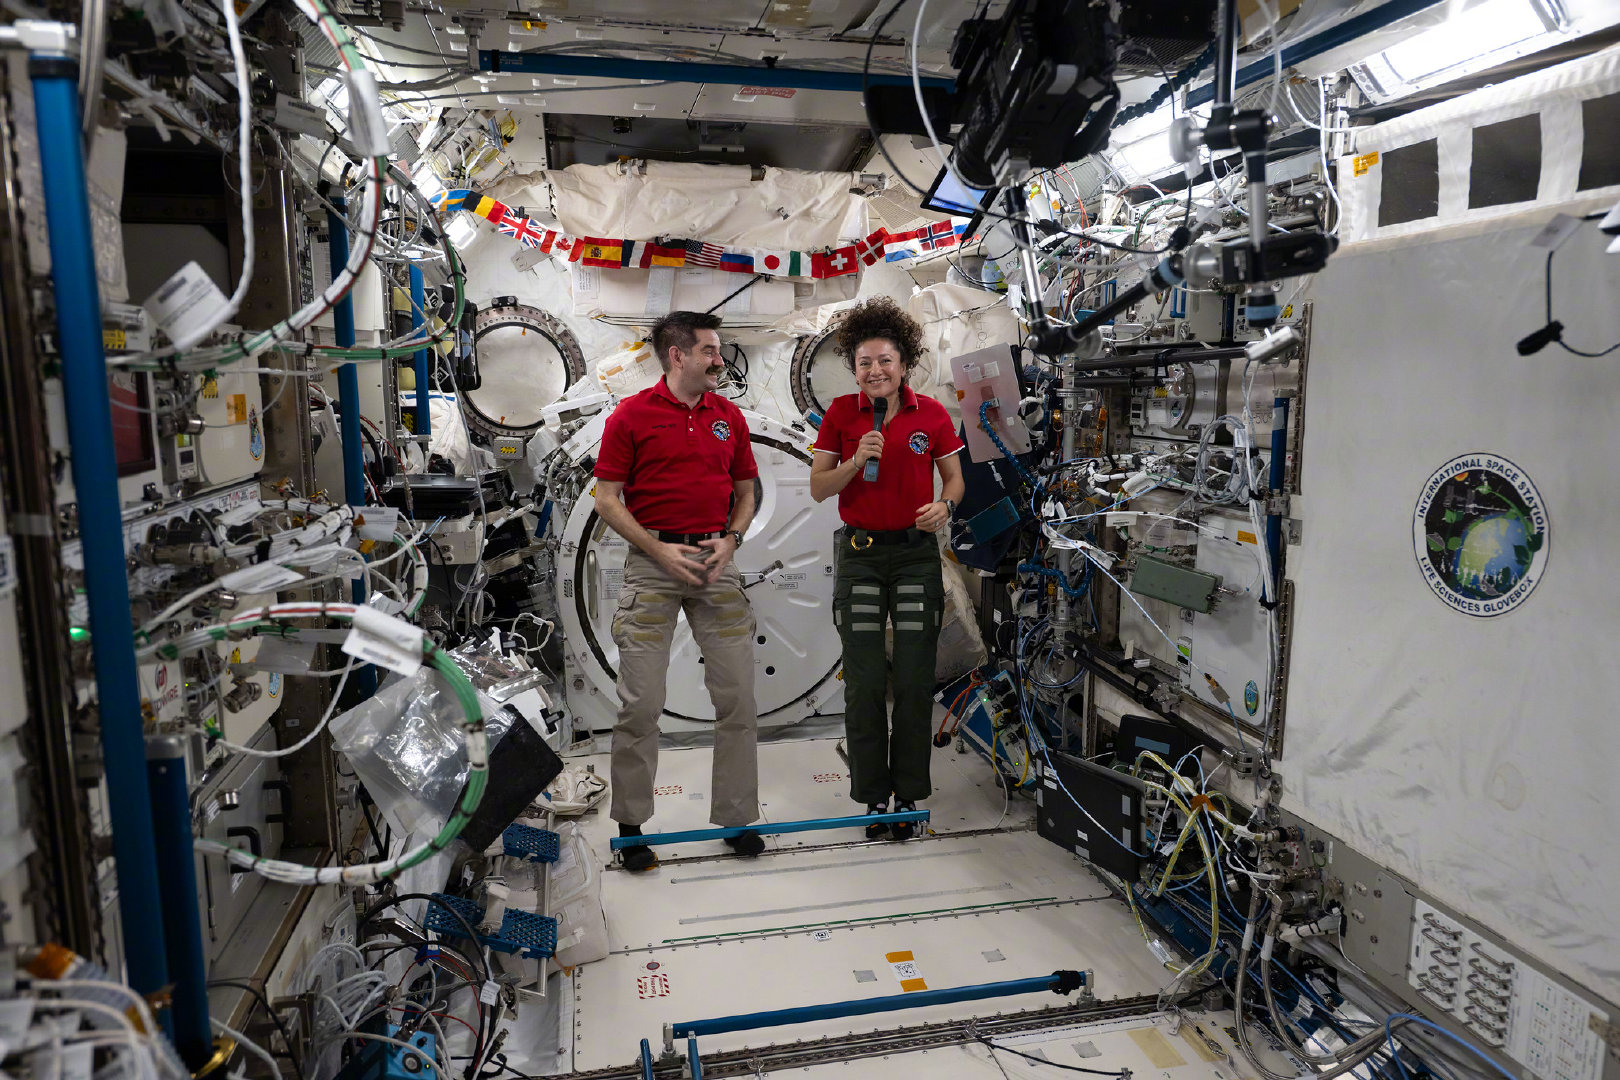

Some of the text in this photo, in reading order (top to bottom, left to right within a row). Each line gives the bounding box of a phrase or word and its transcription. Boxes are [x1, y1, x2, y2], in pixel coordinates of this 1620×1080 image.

[1418, 458, 1545, 535] INTERNATIONAL SPACE STATION
[1420, 557, 1534, 613] LIFE SCIENCES GLOVEBOX
